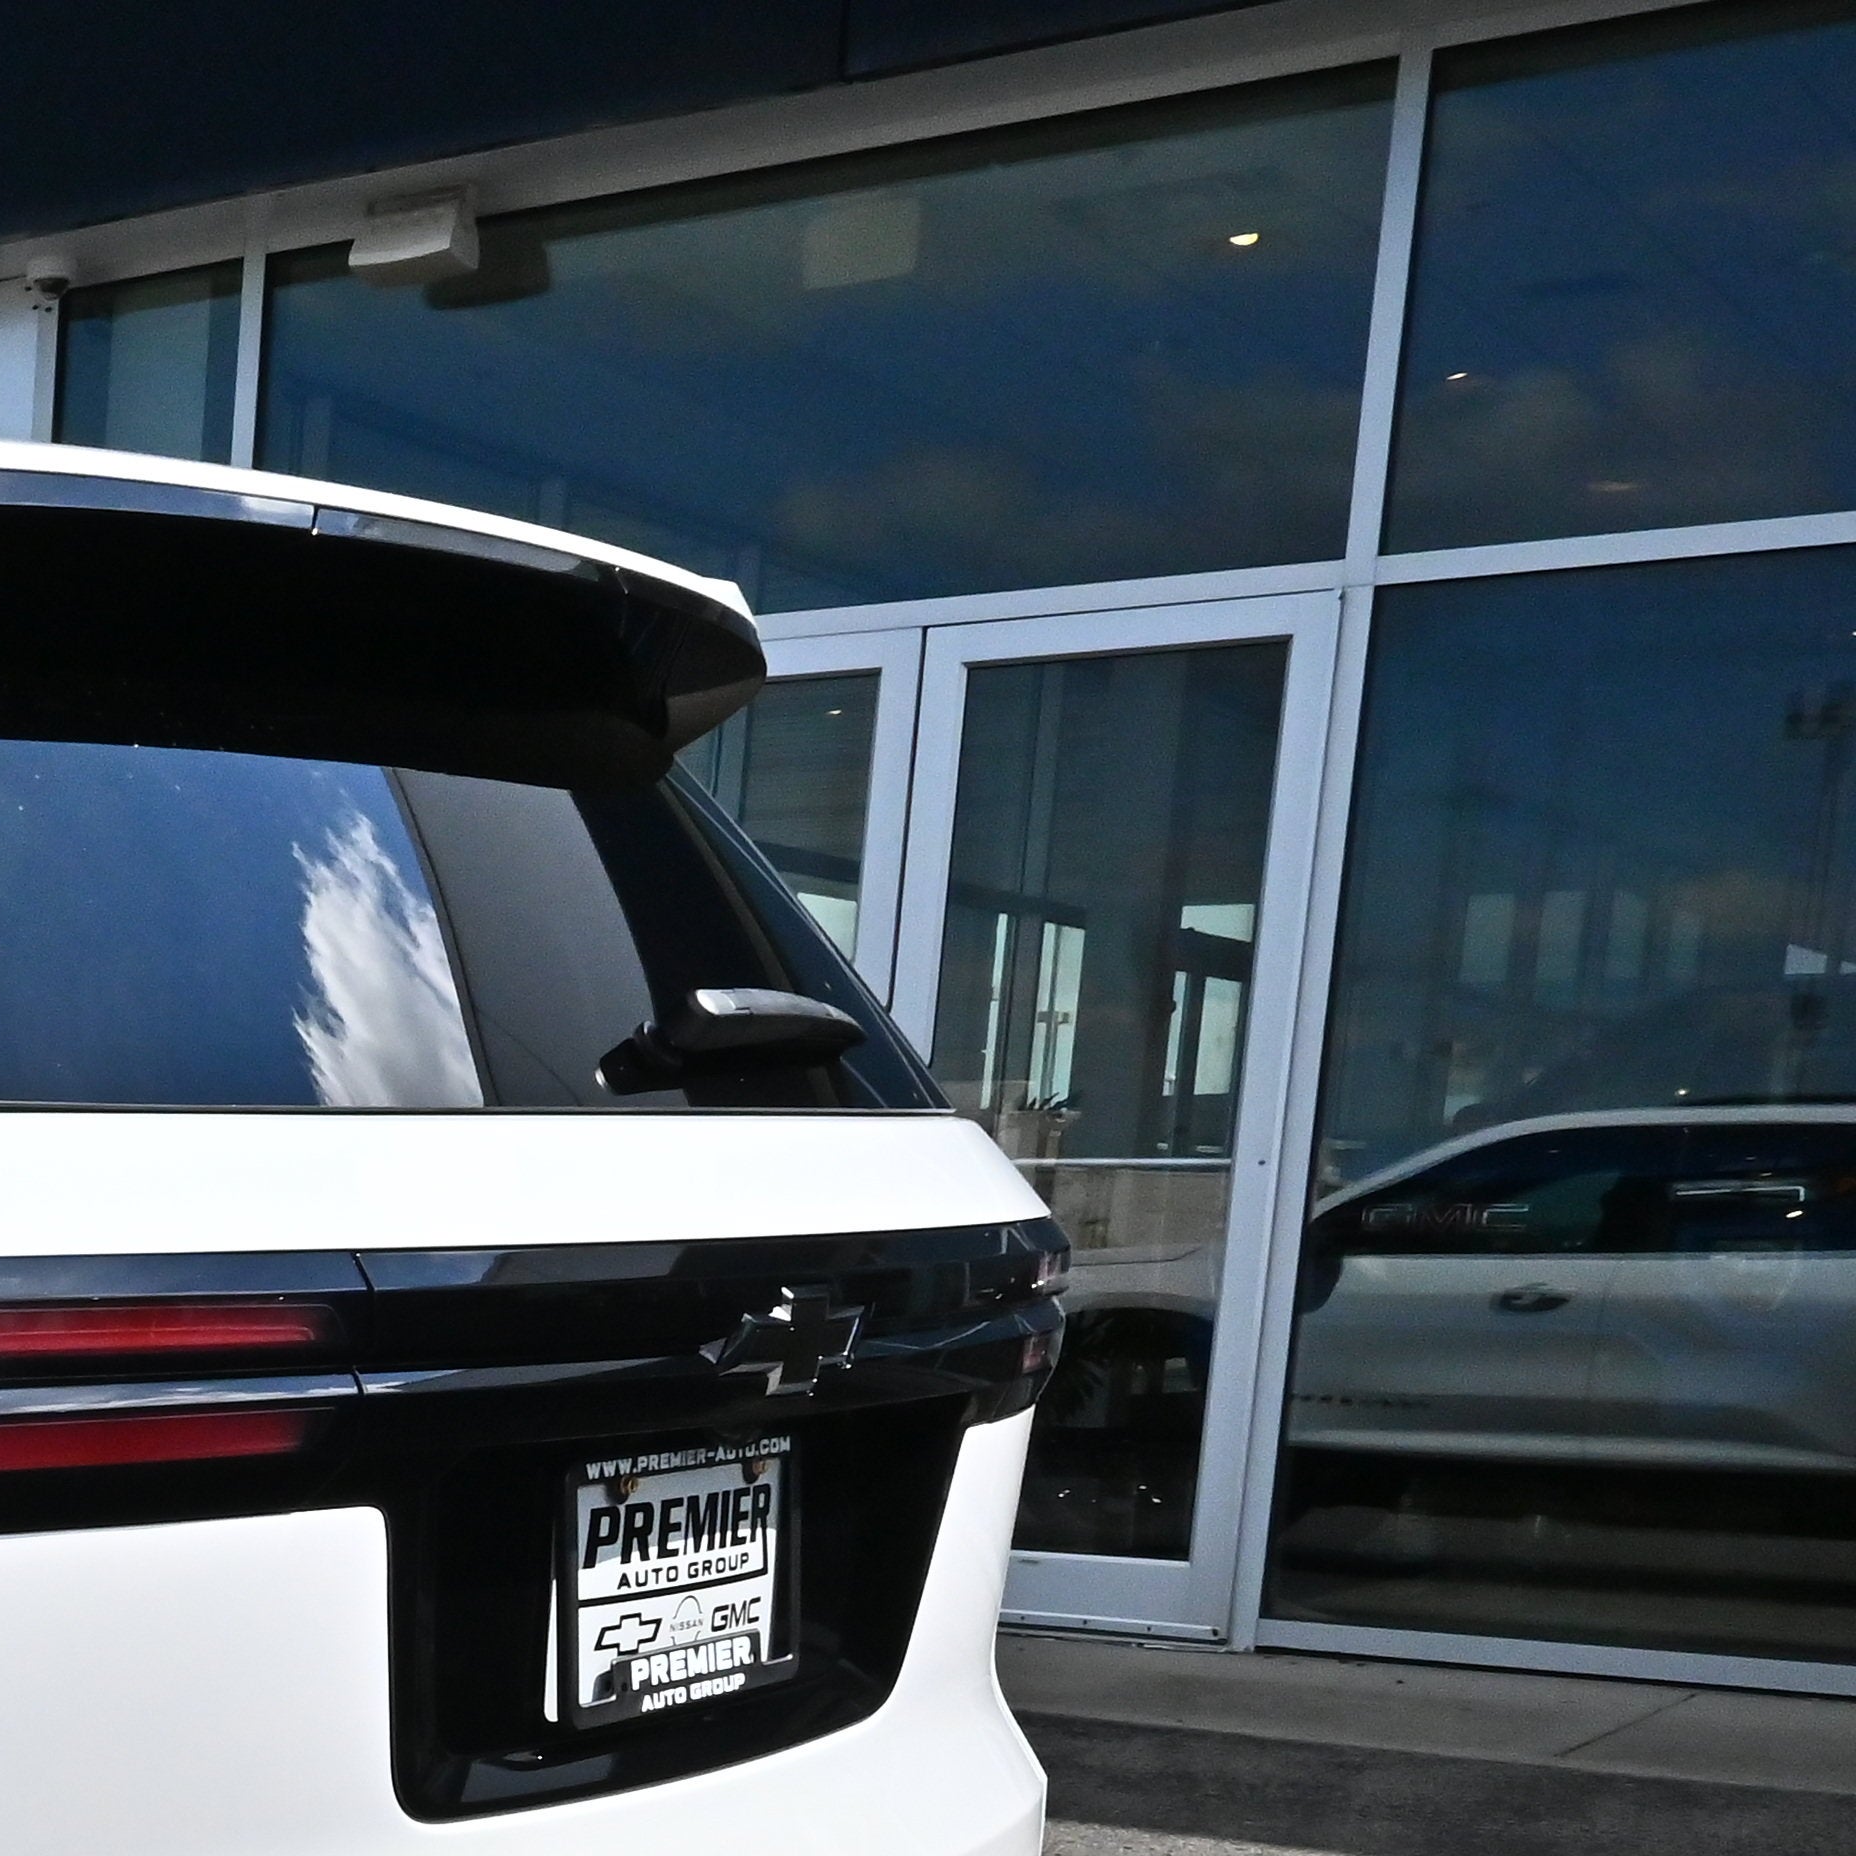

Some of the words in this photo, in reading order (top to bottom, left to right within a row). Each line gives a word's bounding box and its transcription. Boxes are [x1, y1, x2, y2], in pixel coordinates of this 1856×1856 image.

[582, 1483, 772, 1570] PREMIER
[616, 1566, 679, 1590] AUTO
[687, 1552, 750, 1578] GROUP
[670, 1618, 704, 1632] NISSAN
[711, 1596, 762, 1632] GMC
[630, 1636, 751, 1691] PREMIER
[641, 1686, 687, 1713] AUTO
[689, 1672, 746, 1701] GROUP
